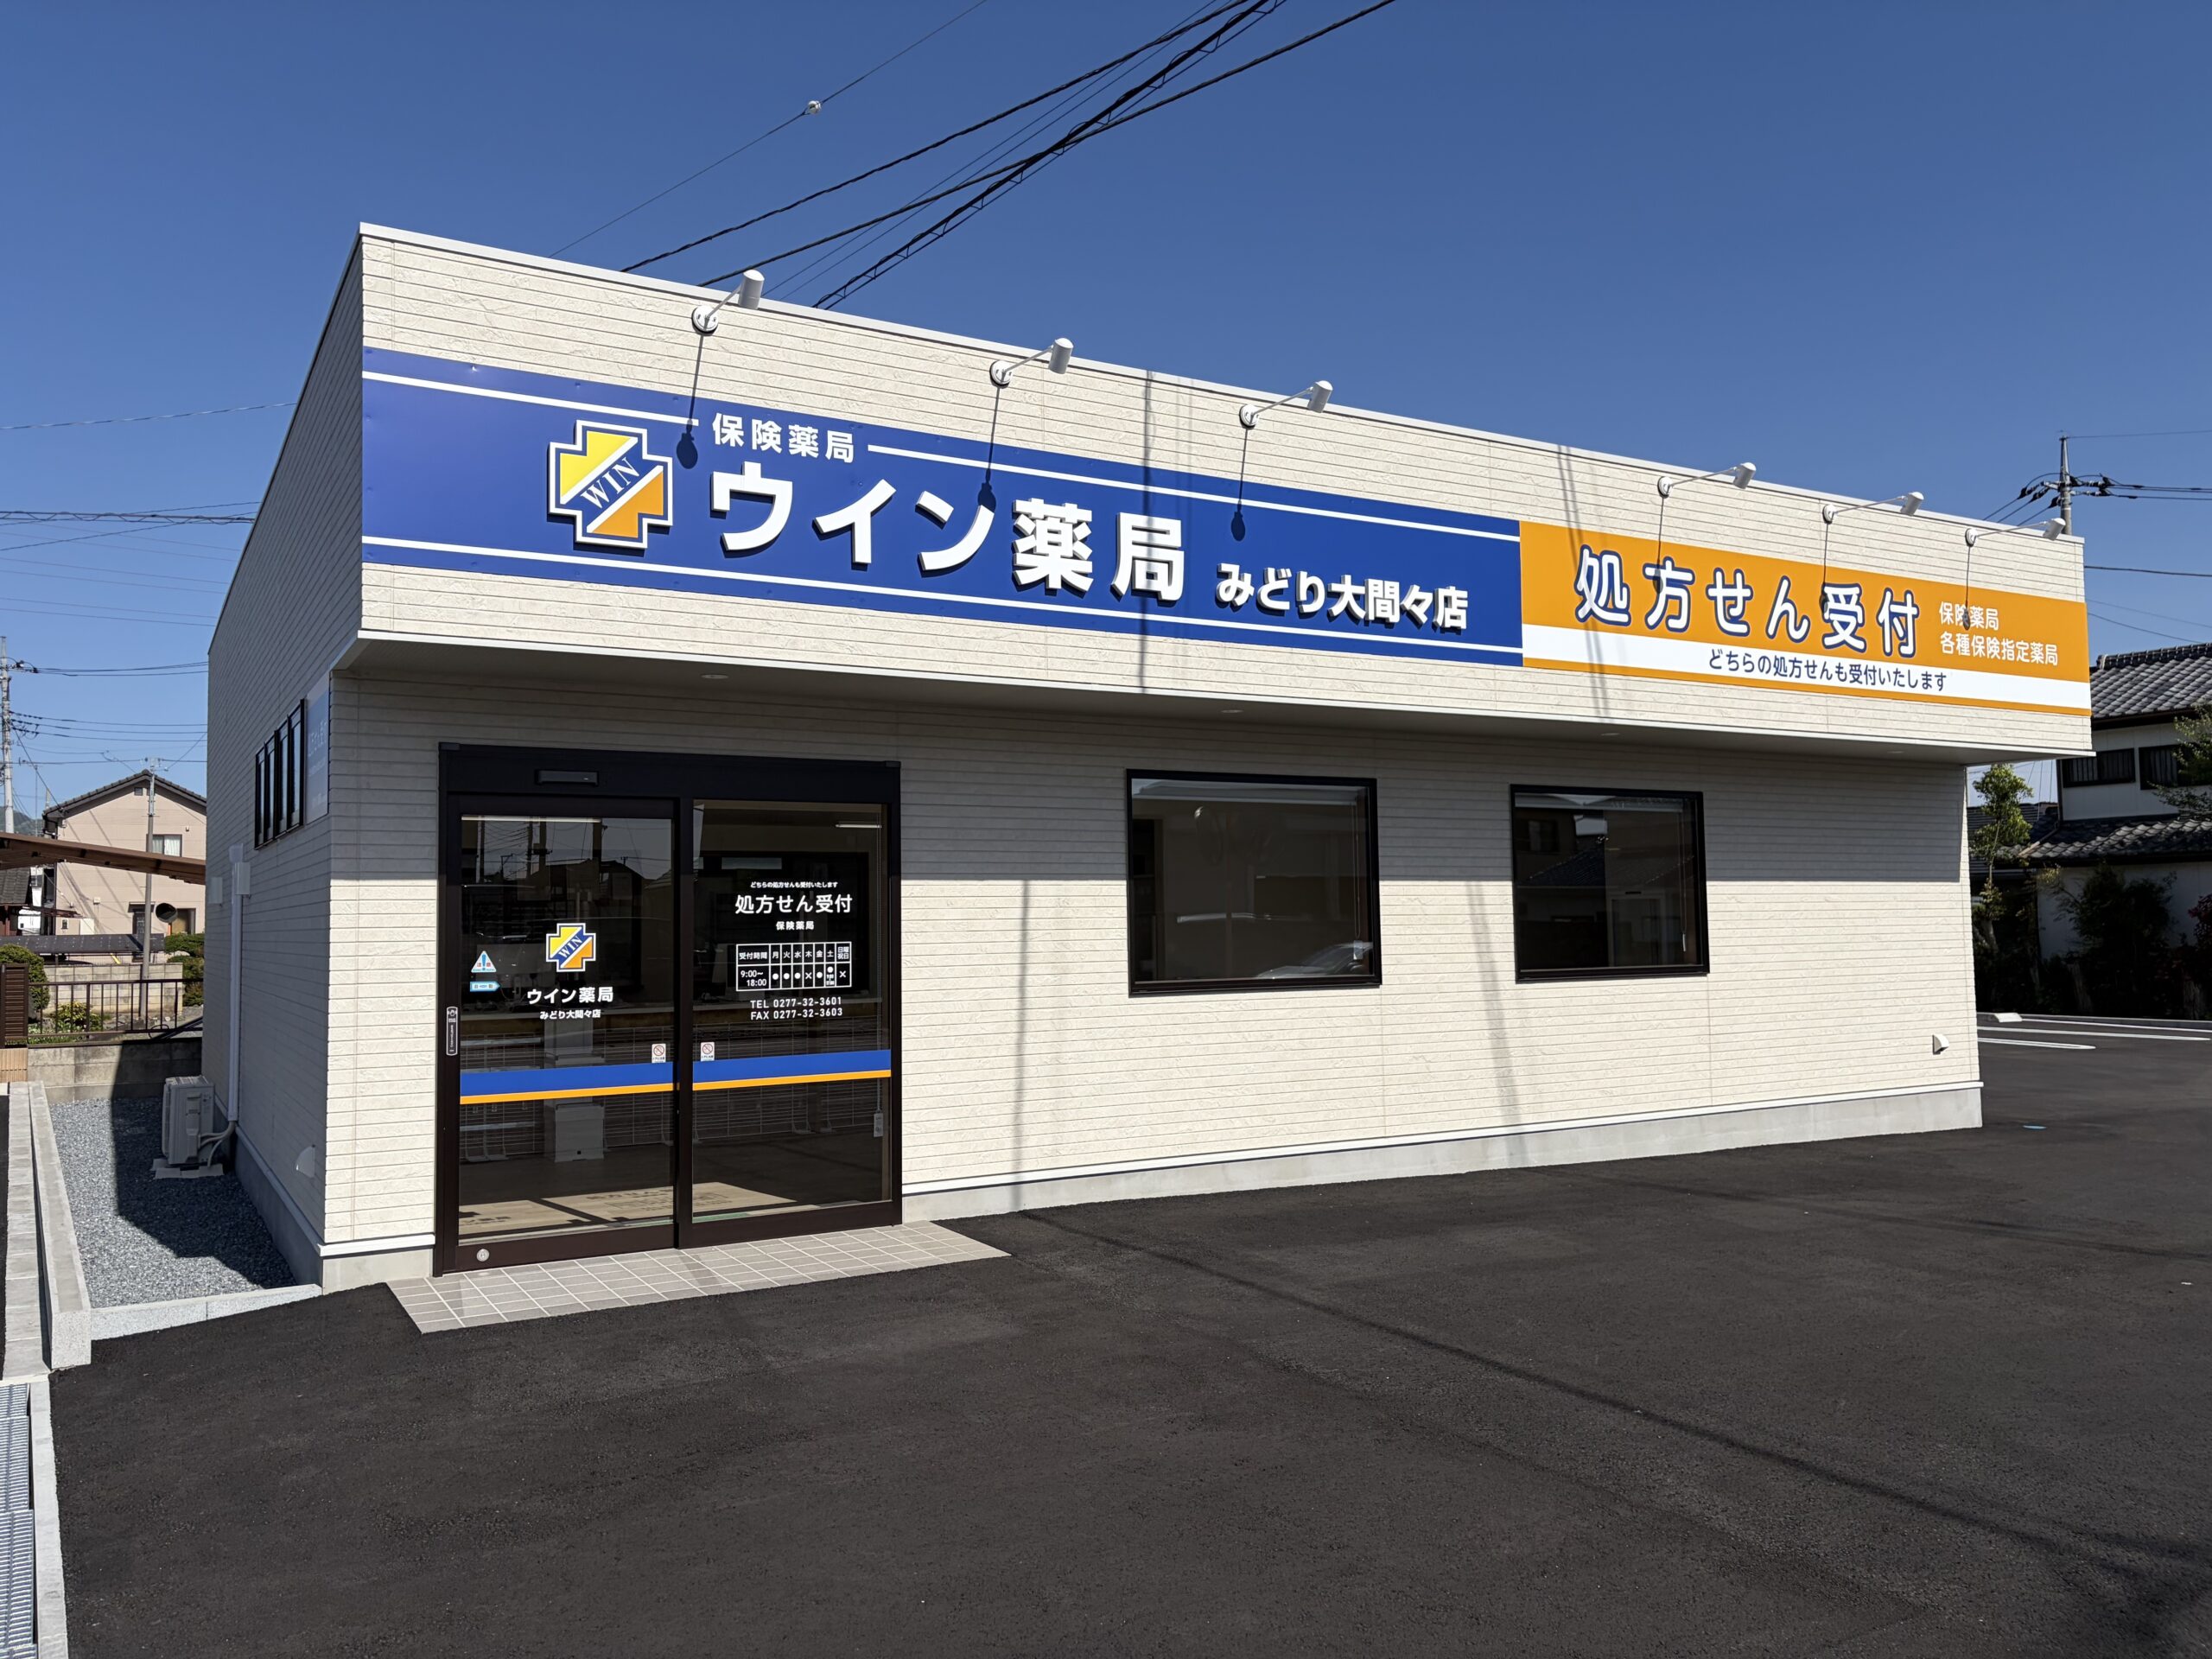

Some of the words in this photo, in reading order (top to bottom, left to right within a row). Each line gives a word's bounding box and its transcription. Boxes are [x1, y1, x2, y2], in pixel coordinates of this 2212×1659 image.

[712, 412, 855, 463] 保険薬局
[580, 456, 640, 509] WIN
[710, 461, 1185, 601] ウイン薬局
[1216, 563, 1468, 631] みどり大間々店
[1574, 544, 1920, 659] 処方せん受付
[1940, 631, 2058, 666] 各種保険指定薬局
[1709, 648, 1947, 691] どちらの処方せんも受付いたします
[734, 893, 853, 914] 処方せん受付
[775, 920, 815, 931] 保険薬局
[558, 934, 582, 958] WIN
[747, 978, 767, 987] 18:00
[527, 986, 614, 1005] ウイン薬局
[750, 1000, 769, 1009] TEL
[773, 996, 842, 1008] 0277-32-3601
[539, 1009, 601, 1020] みどり大間々店
[750, 1011, 770, 1020] FAX
[773, 1007, 842, 1019] 0277-32-3603
